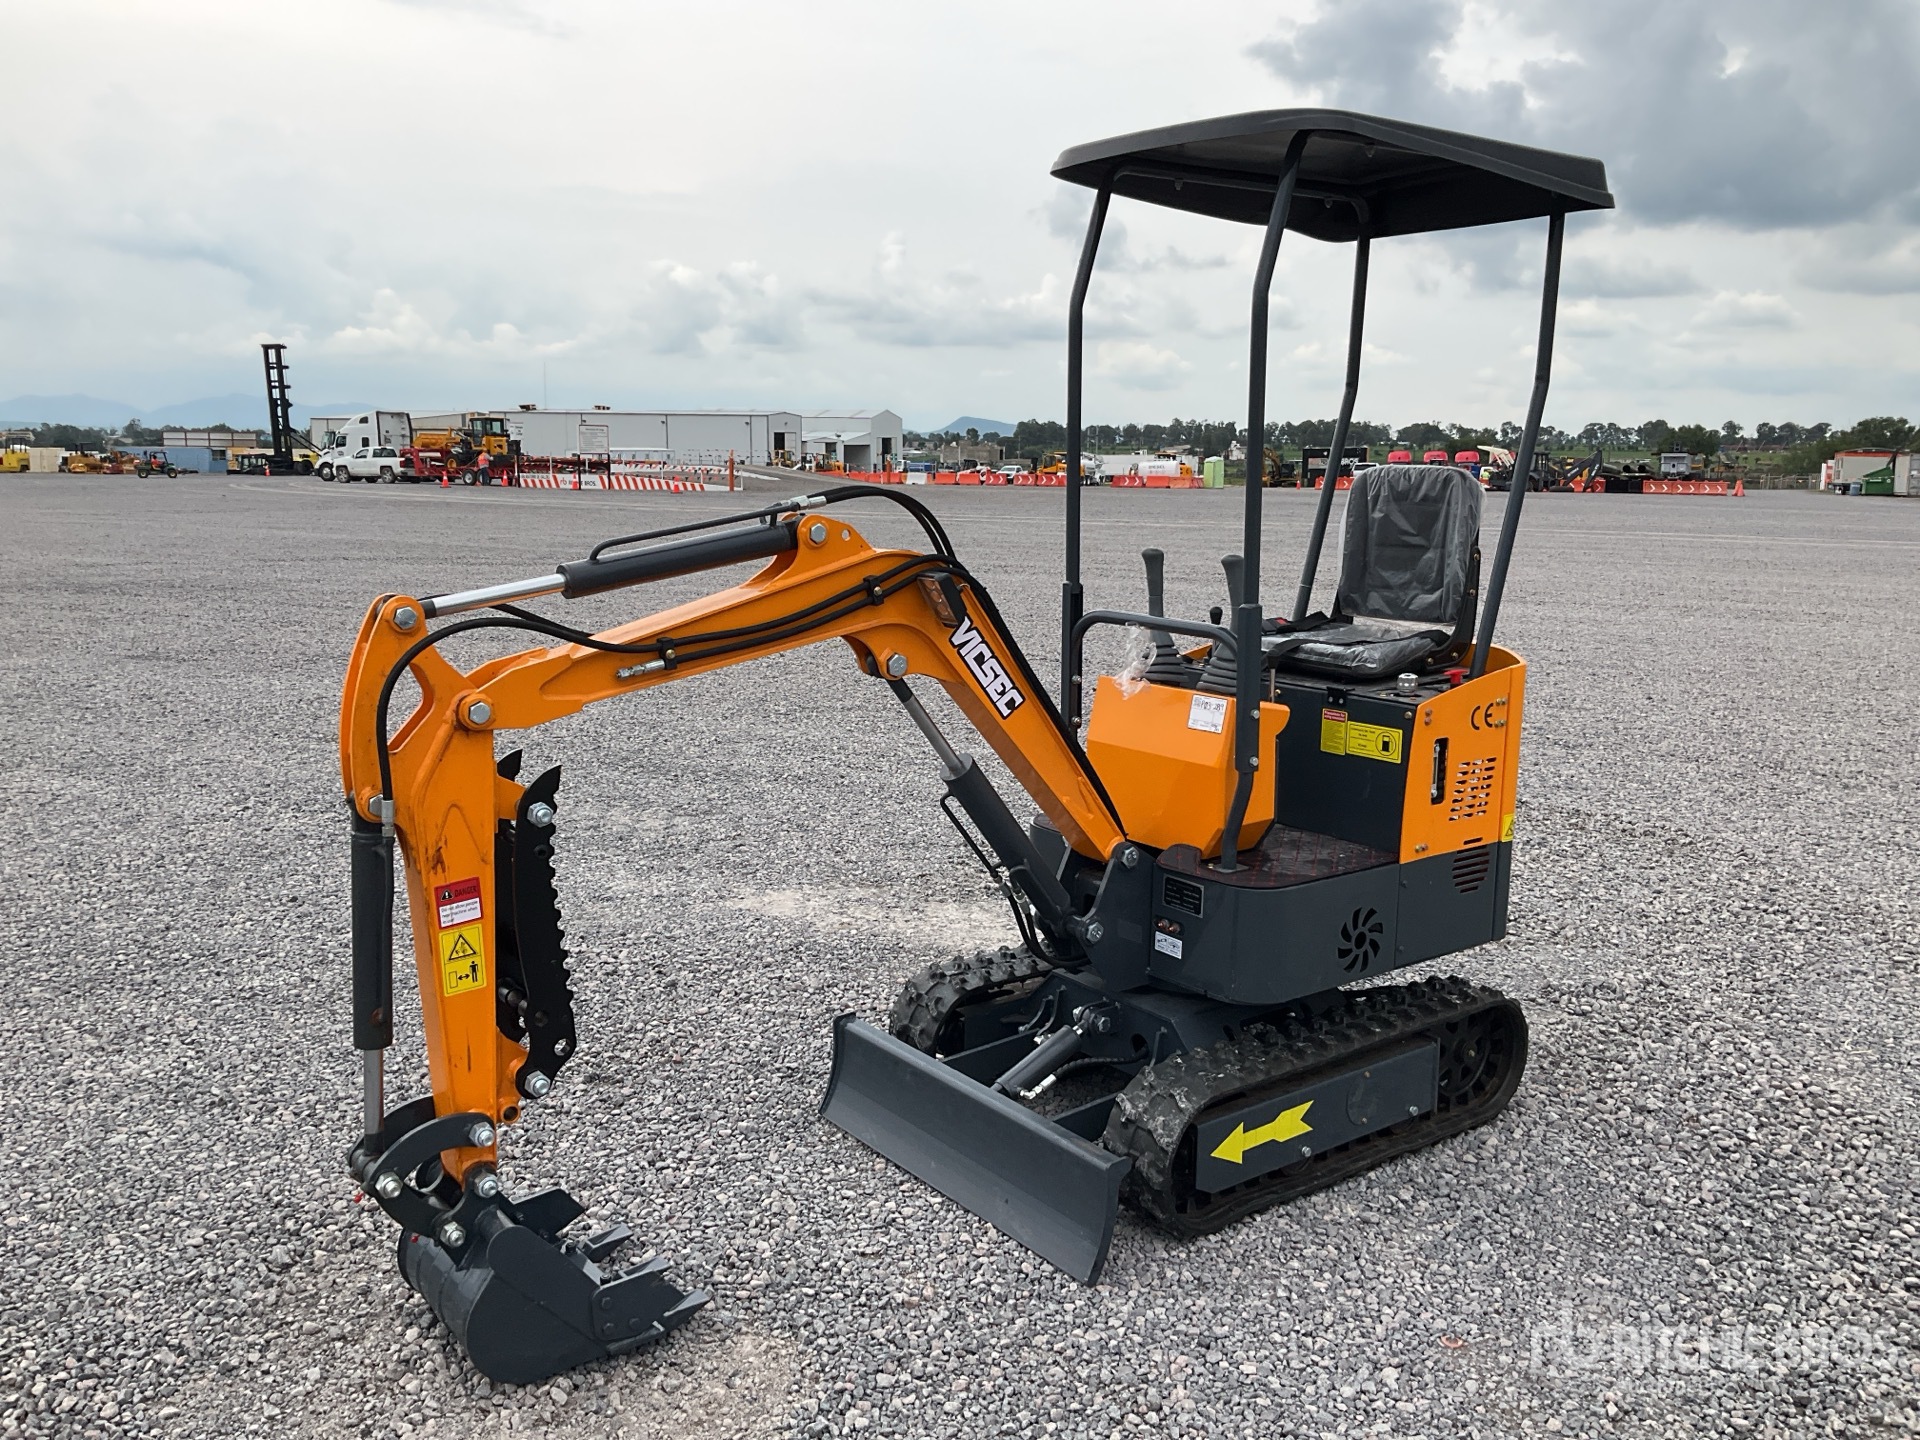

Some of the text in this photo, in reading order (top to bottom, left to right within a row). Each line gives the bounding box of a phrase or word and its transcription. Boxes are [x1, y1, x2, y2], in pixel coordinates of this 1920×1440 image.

[950, 615, 1024, 717] VICSEC
[1470, 702, 1494, 731] CE
[455, 886, 477, 897] DANGER
